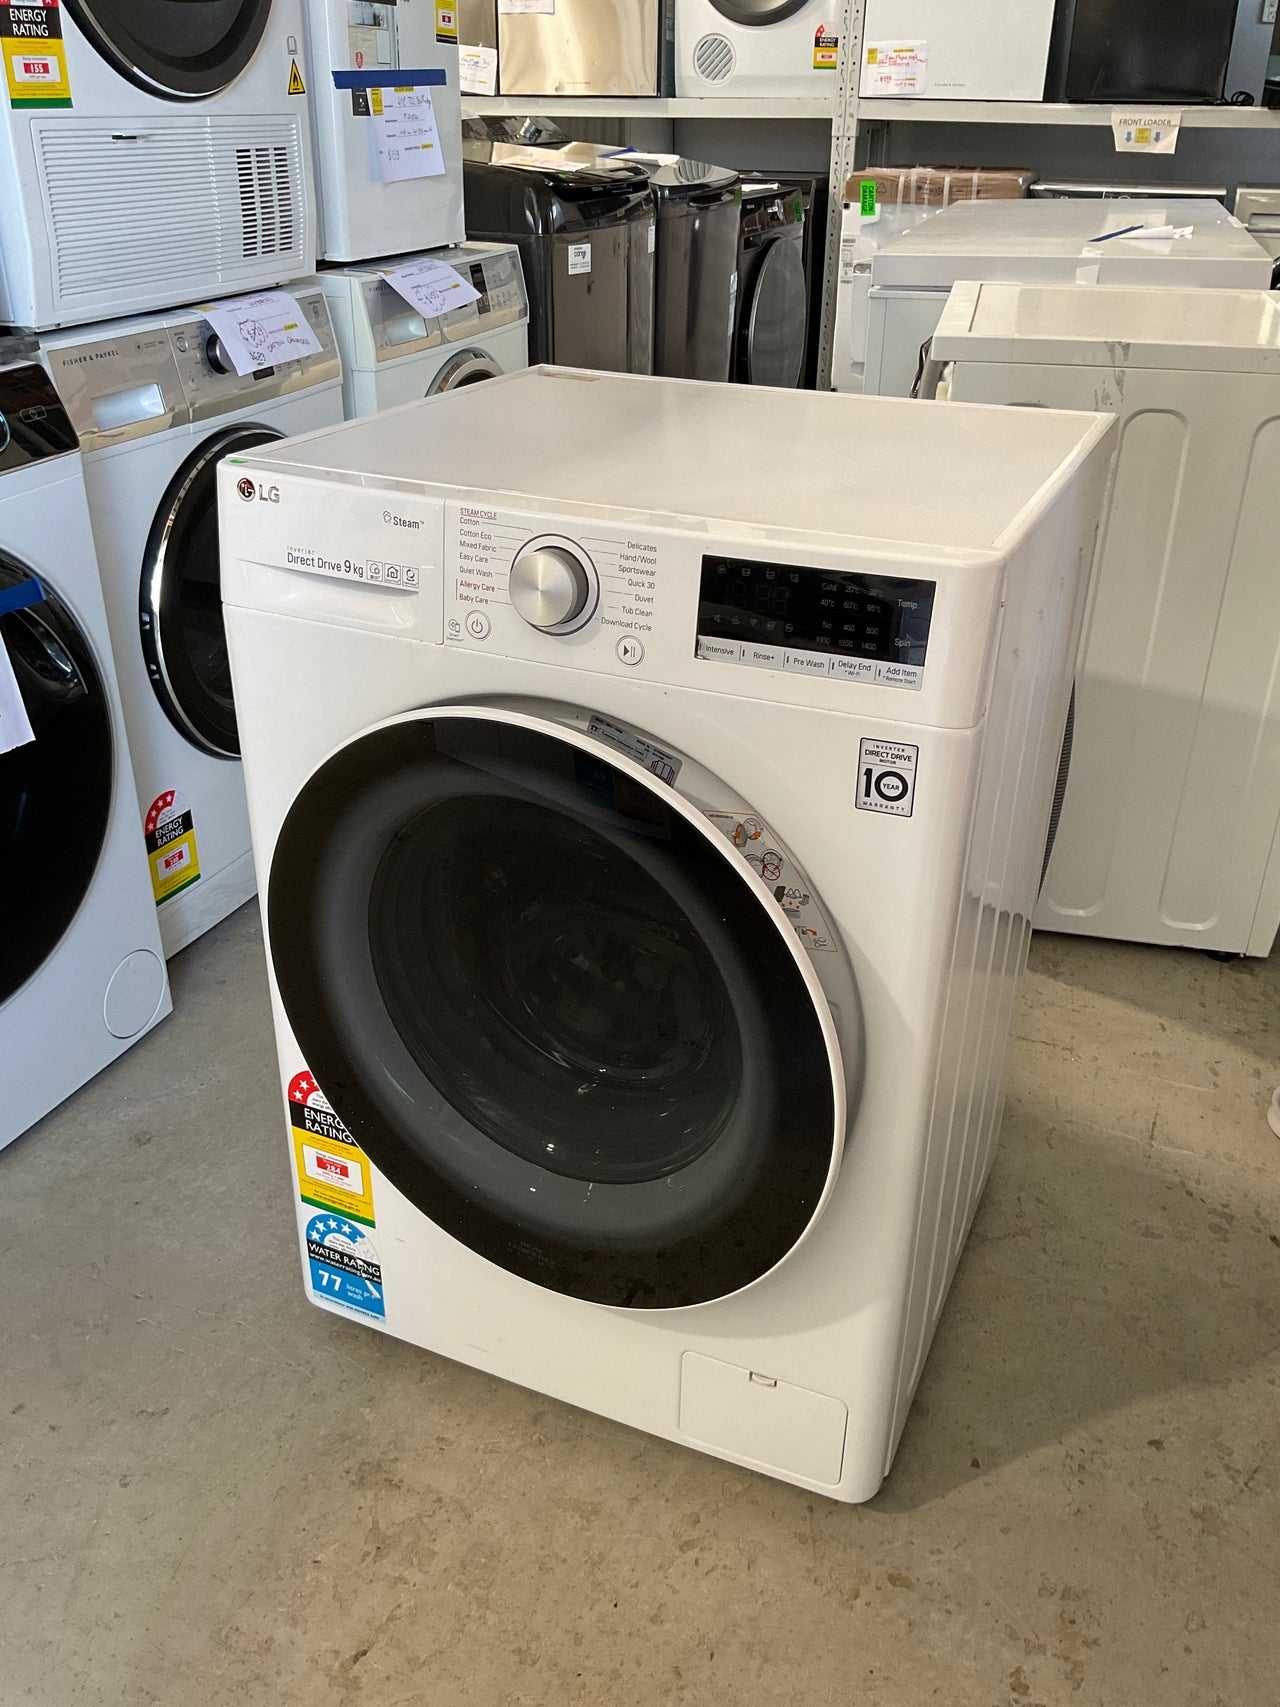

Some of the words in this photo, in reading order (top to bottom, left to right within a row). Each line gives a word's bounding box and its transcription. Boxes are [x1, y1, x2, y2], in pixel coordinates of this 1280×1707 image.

[9, 8, 46, 22] ENERGY
[12, 24, 49, 36] RATING
[30, 64, 44, 73] 155
[1120, 118, 1142, 126] FRONT
[62, 356, 87, 366] FISHER
[95, 350, 120, 360] PAYKEL
[259, 484, 280, 503] LG
[460, 508, 480, 518] STEAM
[480, 510, 497, 519] CYCLE
[460, 517, 480, 526] Cotton
[460, 529, 479, 539] Cotton
[480, 531, 492, 540] Eco
[460, 540, 475, 550] Mixed
[477, 543, 497, 553] Fabric
[628, 542, 657, 552] Delicates
[459, 552, 474, 563] Easy
[475, 555, 488, 564] Care
[620, 553, 657, 564] Hand/Wool
[287, 553, 315, 568] Direct
[318, 558, 342, 572] Drive
[344, 560, 352, 573] 9
[353, 563, 364, 578] kg
[618, 564, 656, 577] Sportswear
[459, 566, 475, 576] Quiet
[475, 568, 493, 578] Wash
[459, 580, 480, 592] Allergy
[481, 583, 495, 592] Care
[628, 578, 645, 589] Quick
[646, 582, 655, 590] 30
[822, 582, 837, 591] Cold
[459, 594, 474, 605] Baby
[475, 596, 489, 605] Care
[634, 594, 654, 604] Duvet
[622, 606, 634, 615] Tub
[634, 608, 653, 617] Clean
[601, 617, 632, 629] Download
[633, 621, 652, 632] Cycle
[822, 621, 832, 629] No
[894, 637, 911, 648] Spin
[705, 645, 734, 656] Intensive
[753, 652, 775, 662] Rinse+
[793, 658, 805, 666] Pre
[805, 659, 824, 669] Wash
[838, 660, 857, 672] Delay
[857, 663, 871, 672] End
[886, 667, 900, 676] Add
[901, 668, 917, 678] Item
[873, 744, 905, 752] INVERTER
[865, 749, 890, 758] DIRECT
[890, 753, 912, 762] DRIVE
[864, 768, 908, 802] 10
[883, 783, 900, 791] YEAR
[862, 801, 905, 812] WARRANTY
[155, 817, 183, 839] ENERGY
[157, 826, 184, 847] RATING
[304, 1108, 344, 1129] ENERG
[306, 1119, 352, 1143] RATING
[326, 1164, 340, 1174] 284
[308, 1242, 341, 1262] WATER
[318, 1270, 342, 1291] 77
